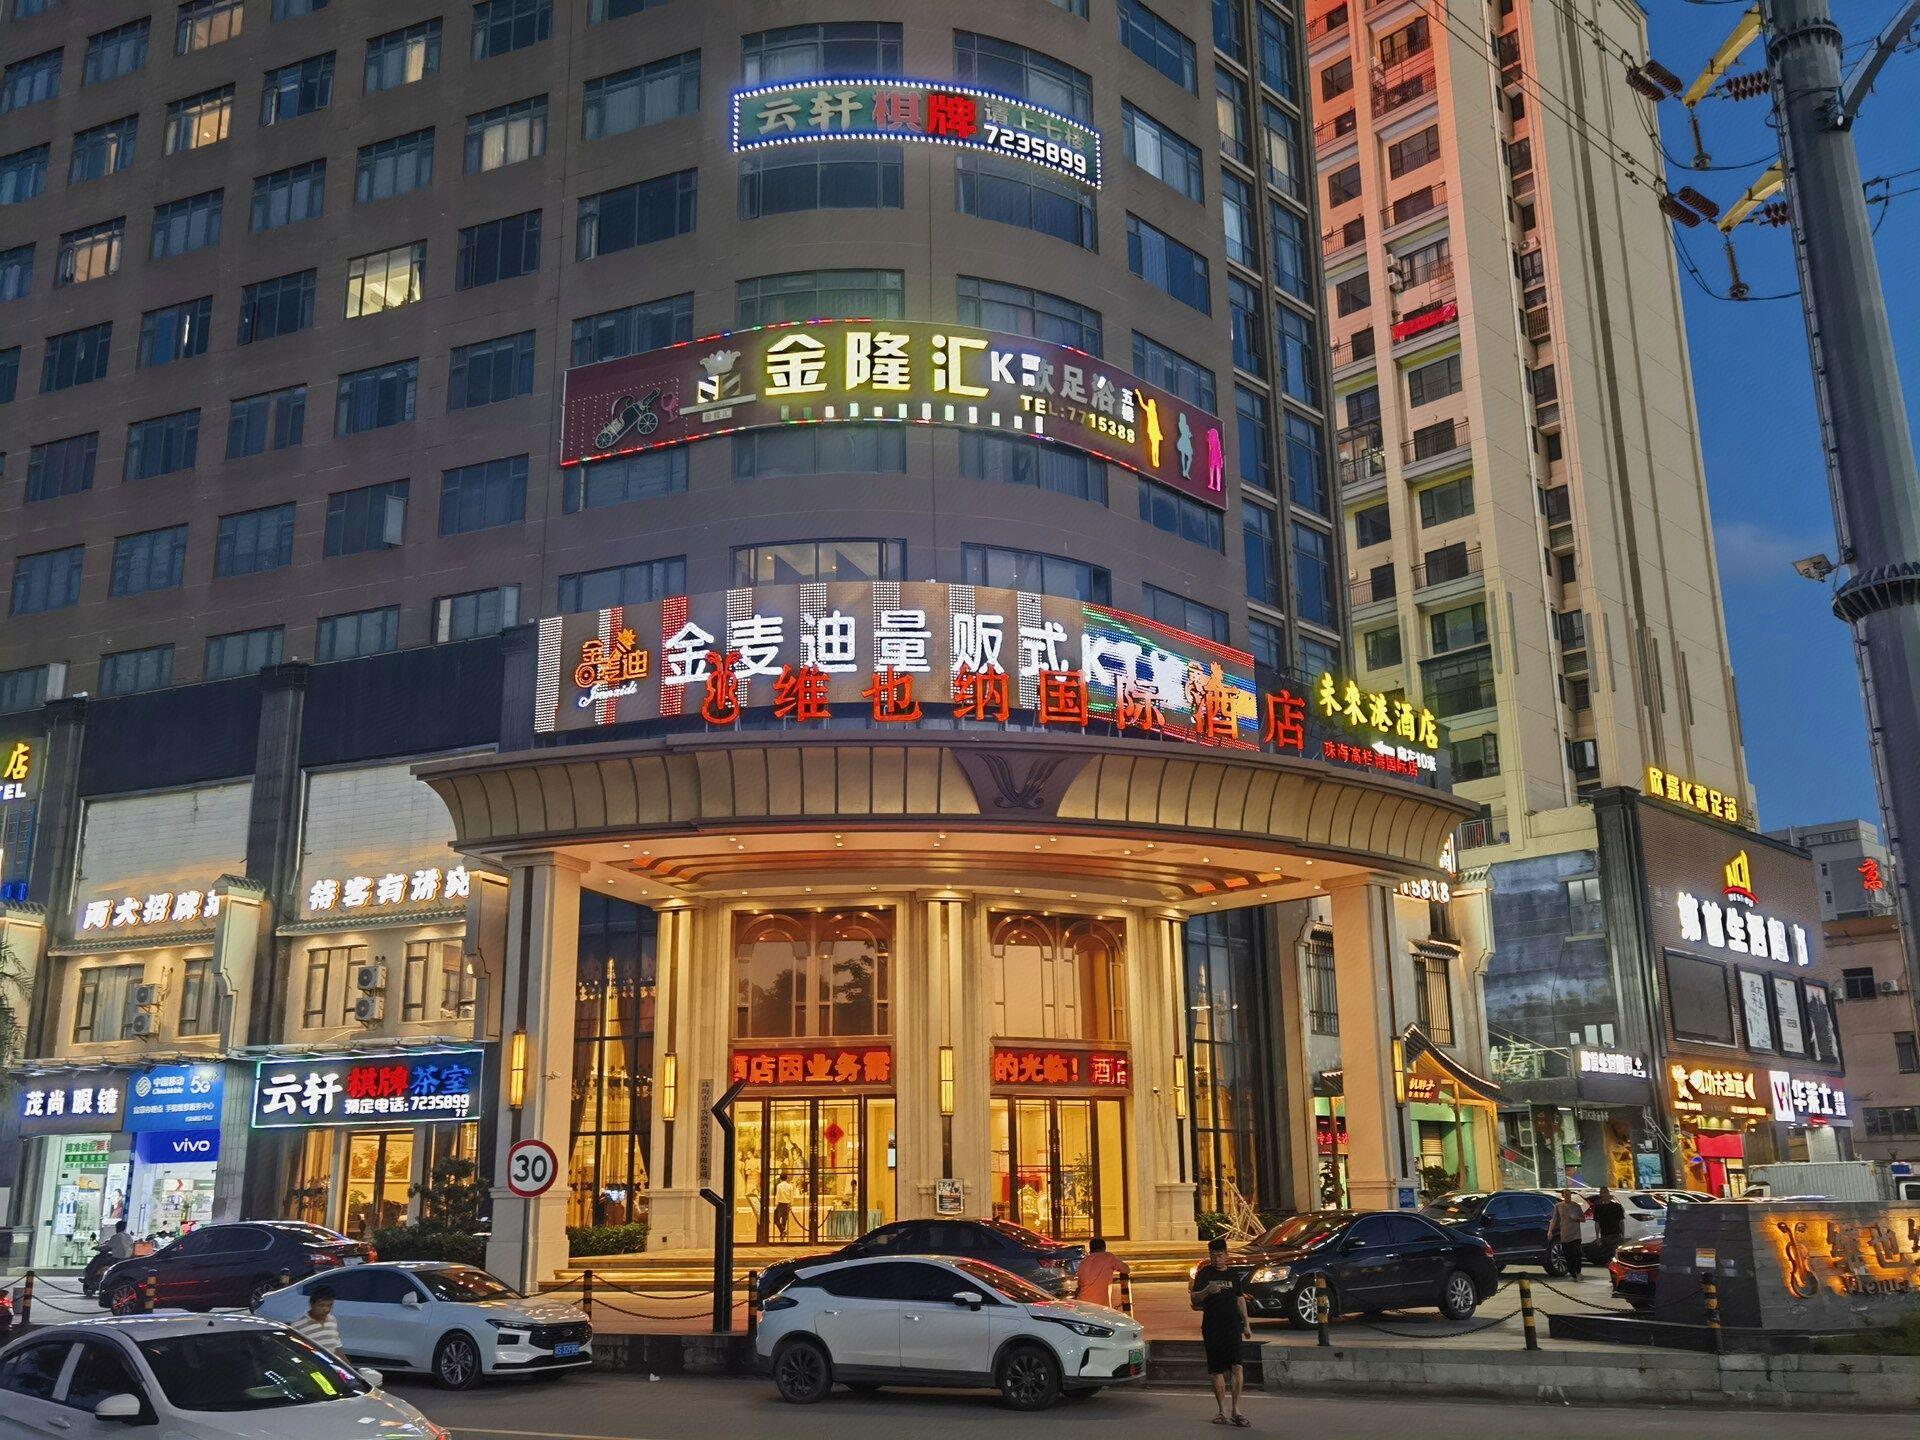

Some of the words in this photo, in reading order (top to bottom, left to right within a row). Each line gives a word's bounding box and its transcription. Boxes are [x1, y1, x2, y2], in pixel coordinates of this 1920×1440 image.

[756, 91, 977, 139] 云轩棋牌
[985, 101, 1085, 149] 请上七楼
[984, 124, 1087, 175] 7235899
[765, 332, 989, 395] 金隆汇
[774, 662, 1306, 750] 维也纳国际酒店
[4, 743, 29, 780] 店
[24, 1088, 119, 1116] 茂尚眼镜
[189, 1076, 212, 1094] 5G
[173, 1138, 210, 1152] vivo
[512, 1155, 548, 1183] 30
